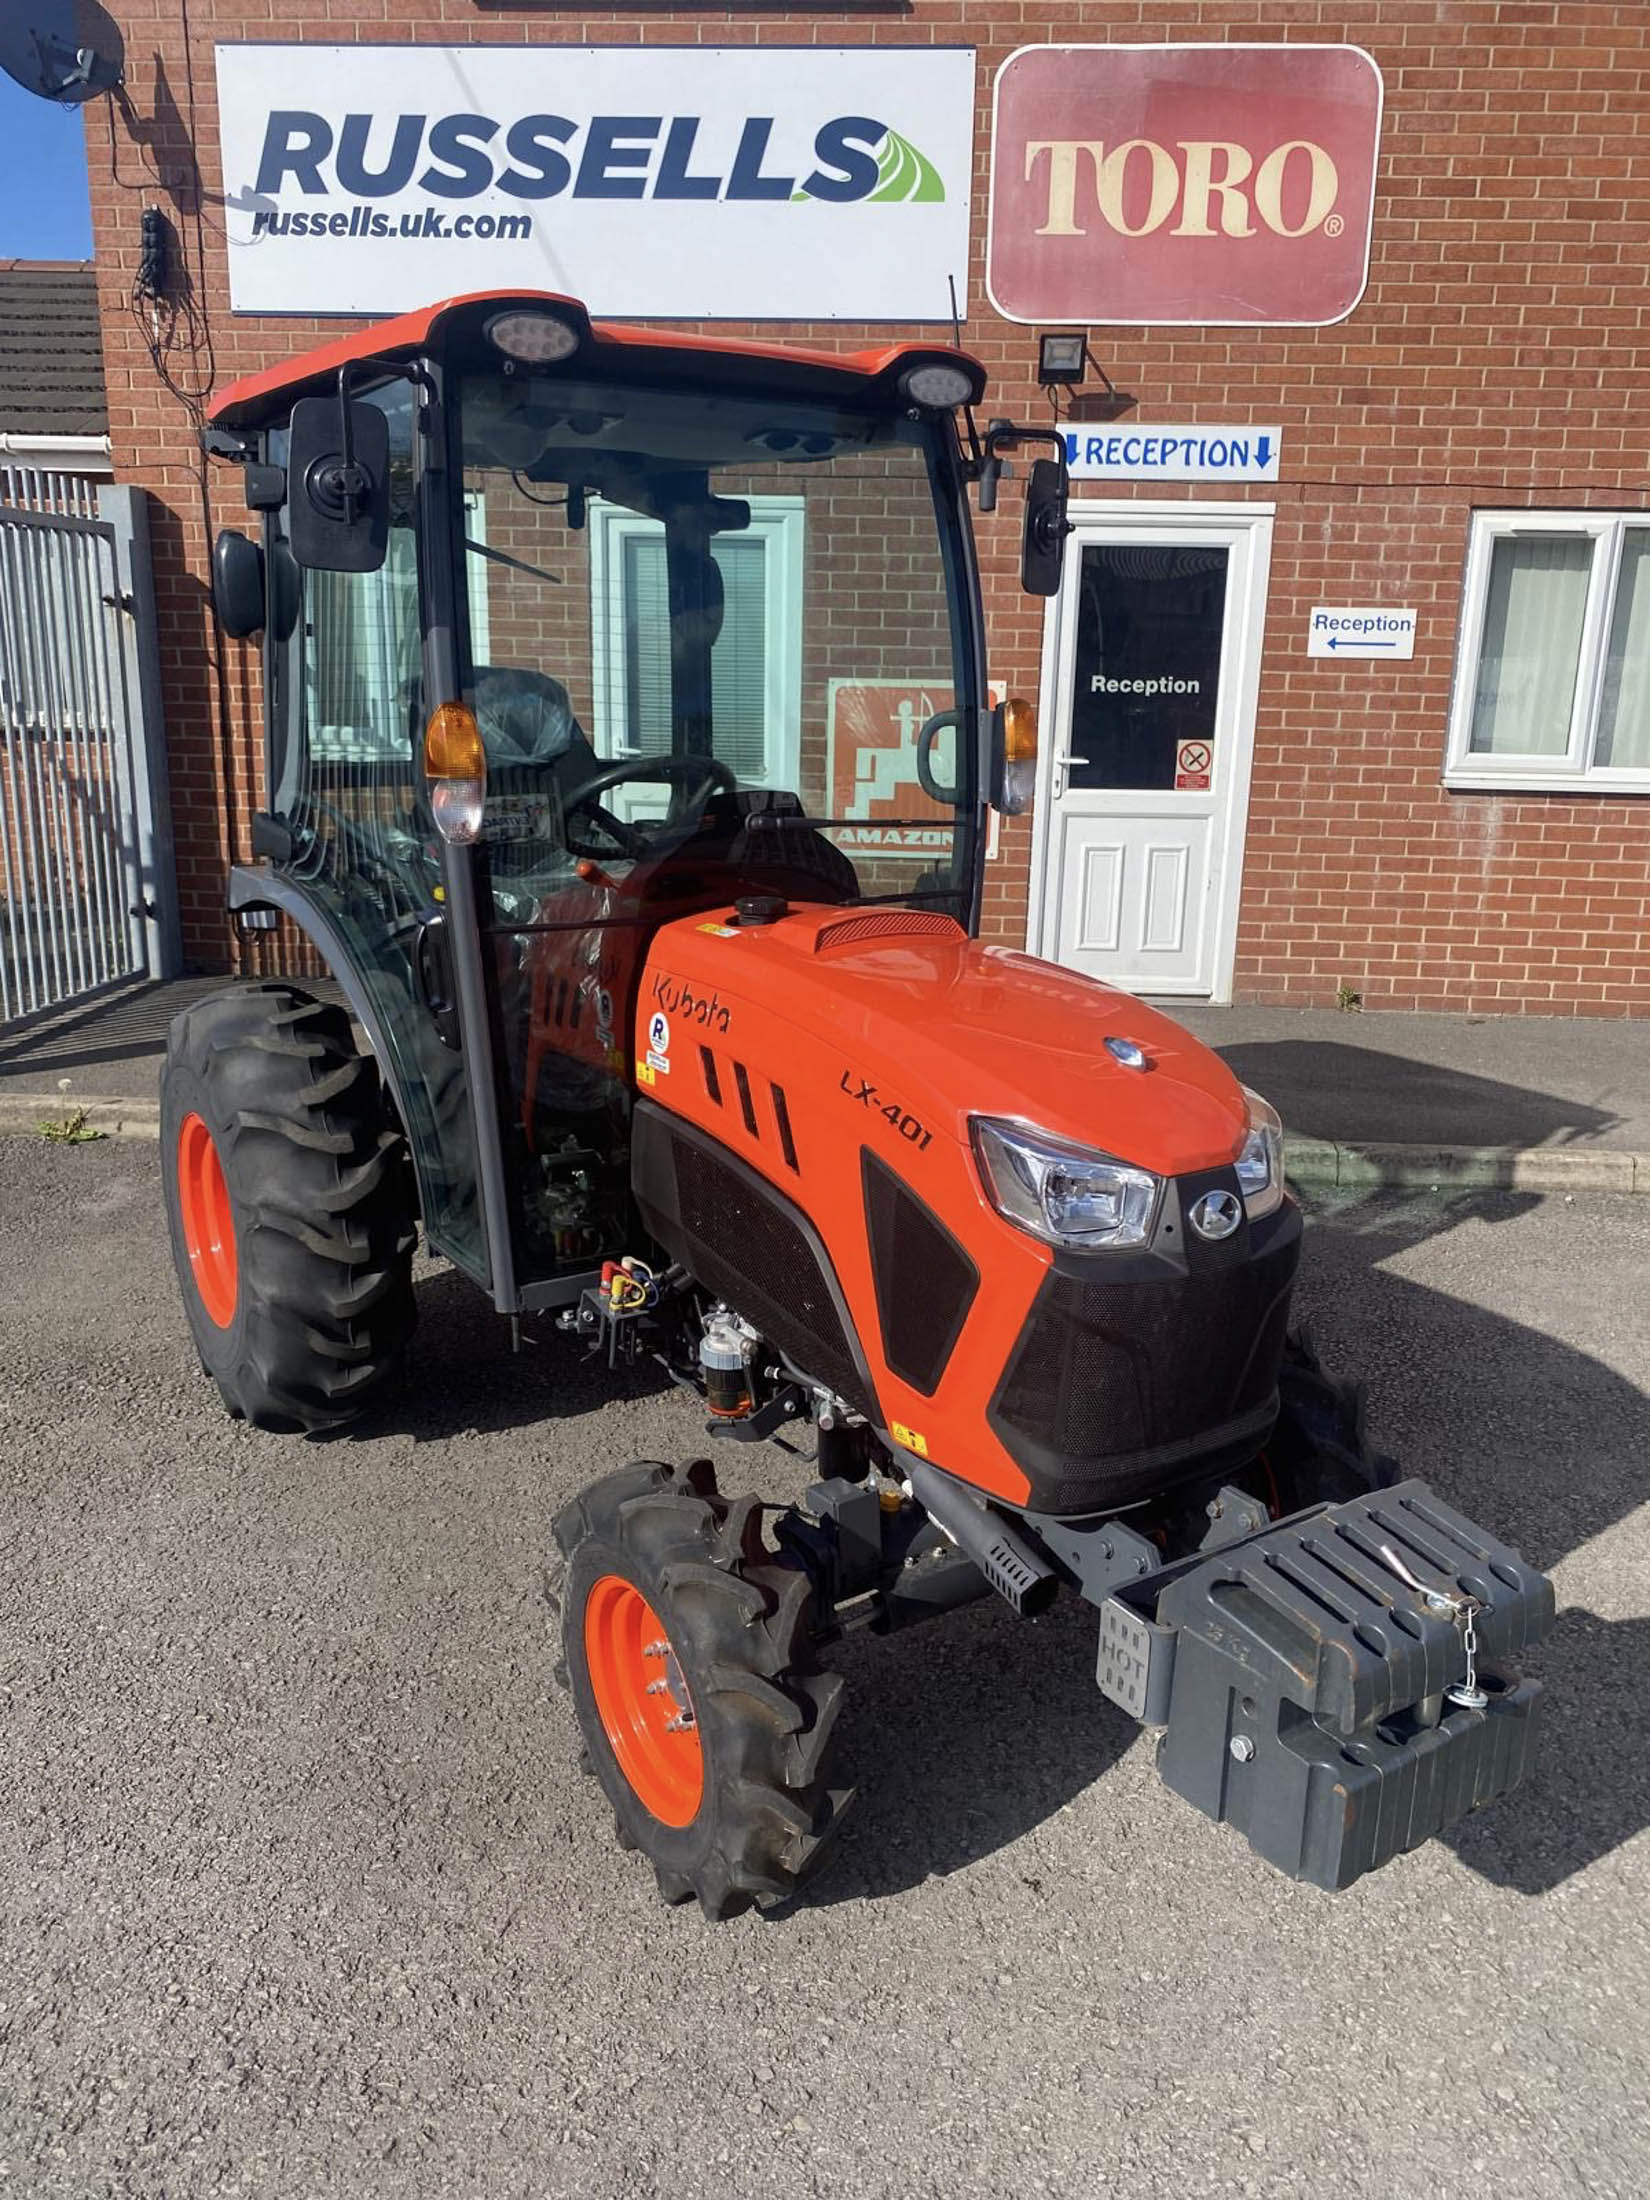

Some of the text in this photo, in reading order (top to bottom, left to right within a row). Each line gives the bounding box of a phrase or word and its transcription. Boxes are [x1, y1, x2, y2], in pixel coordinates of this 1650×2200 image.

[255, 110, 891, 202] RUSSELLS
[252, 206, 532, 239] russells.uk.com
[1085, 437, 1250, 469] RECEPTION
[1314, 614, 1412, 634] Reception
[1091, 675, 1200, 696] Reception
[837, 828, 954, 846] AMAZON
[653, 973, 730, 1034] Kubota
[652, 1017, 664, 1040] R
[840, 1069, 933, 1152] LX-401
[1101, 1634, 1146, 1681] HOT
